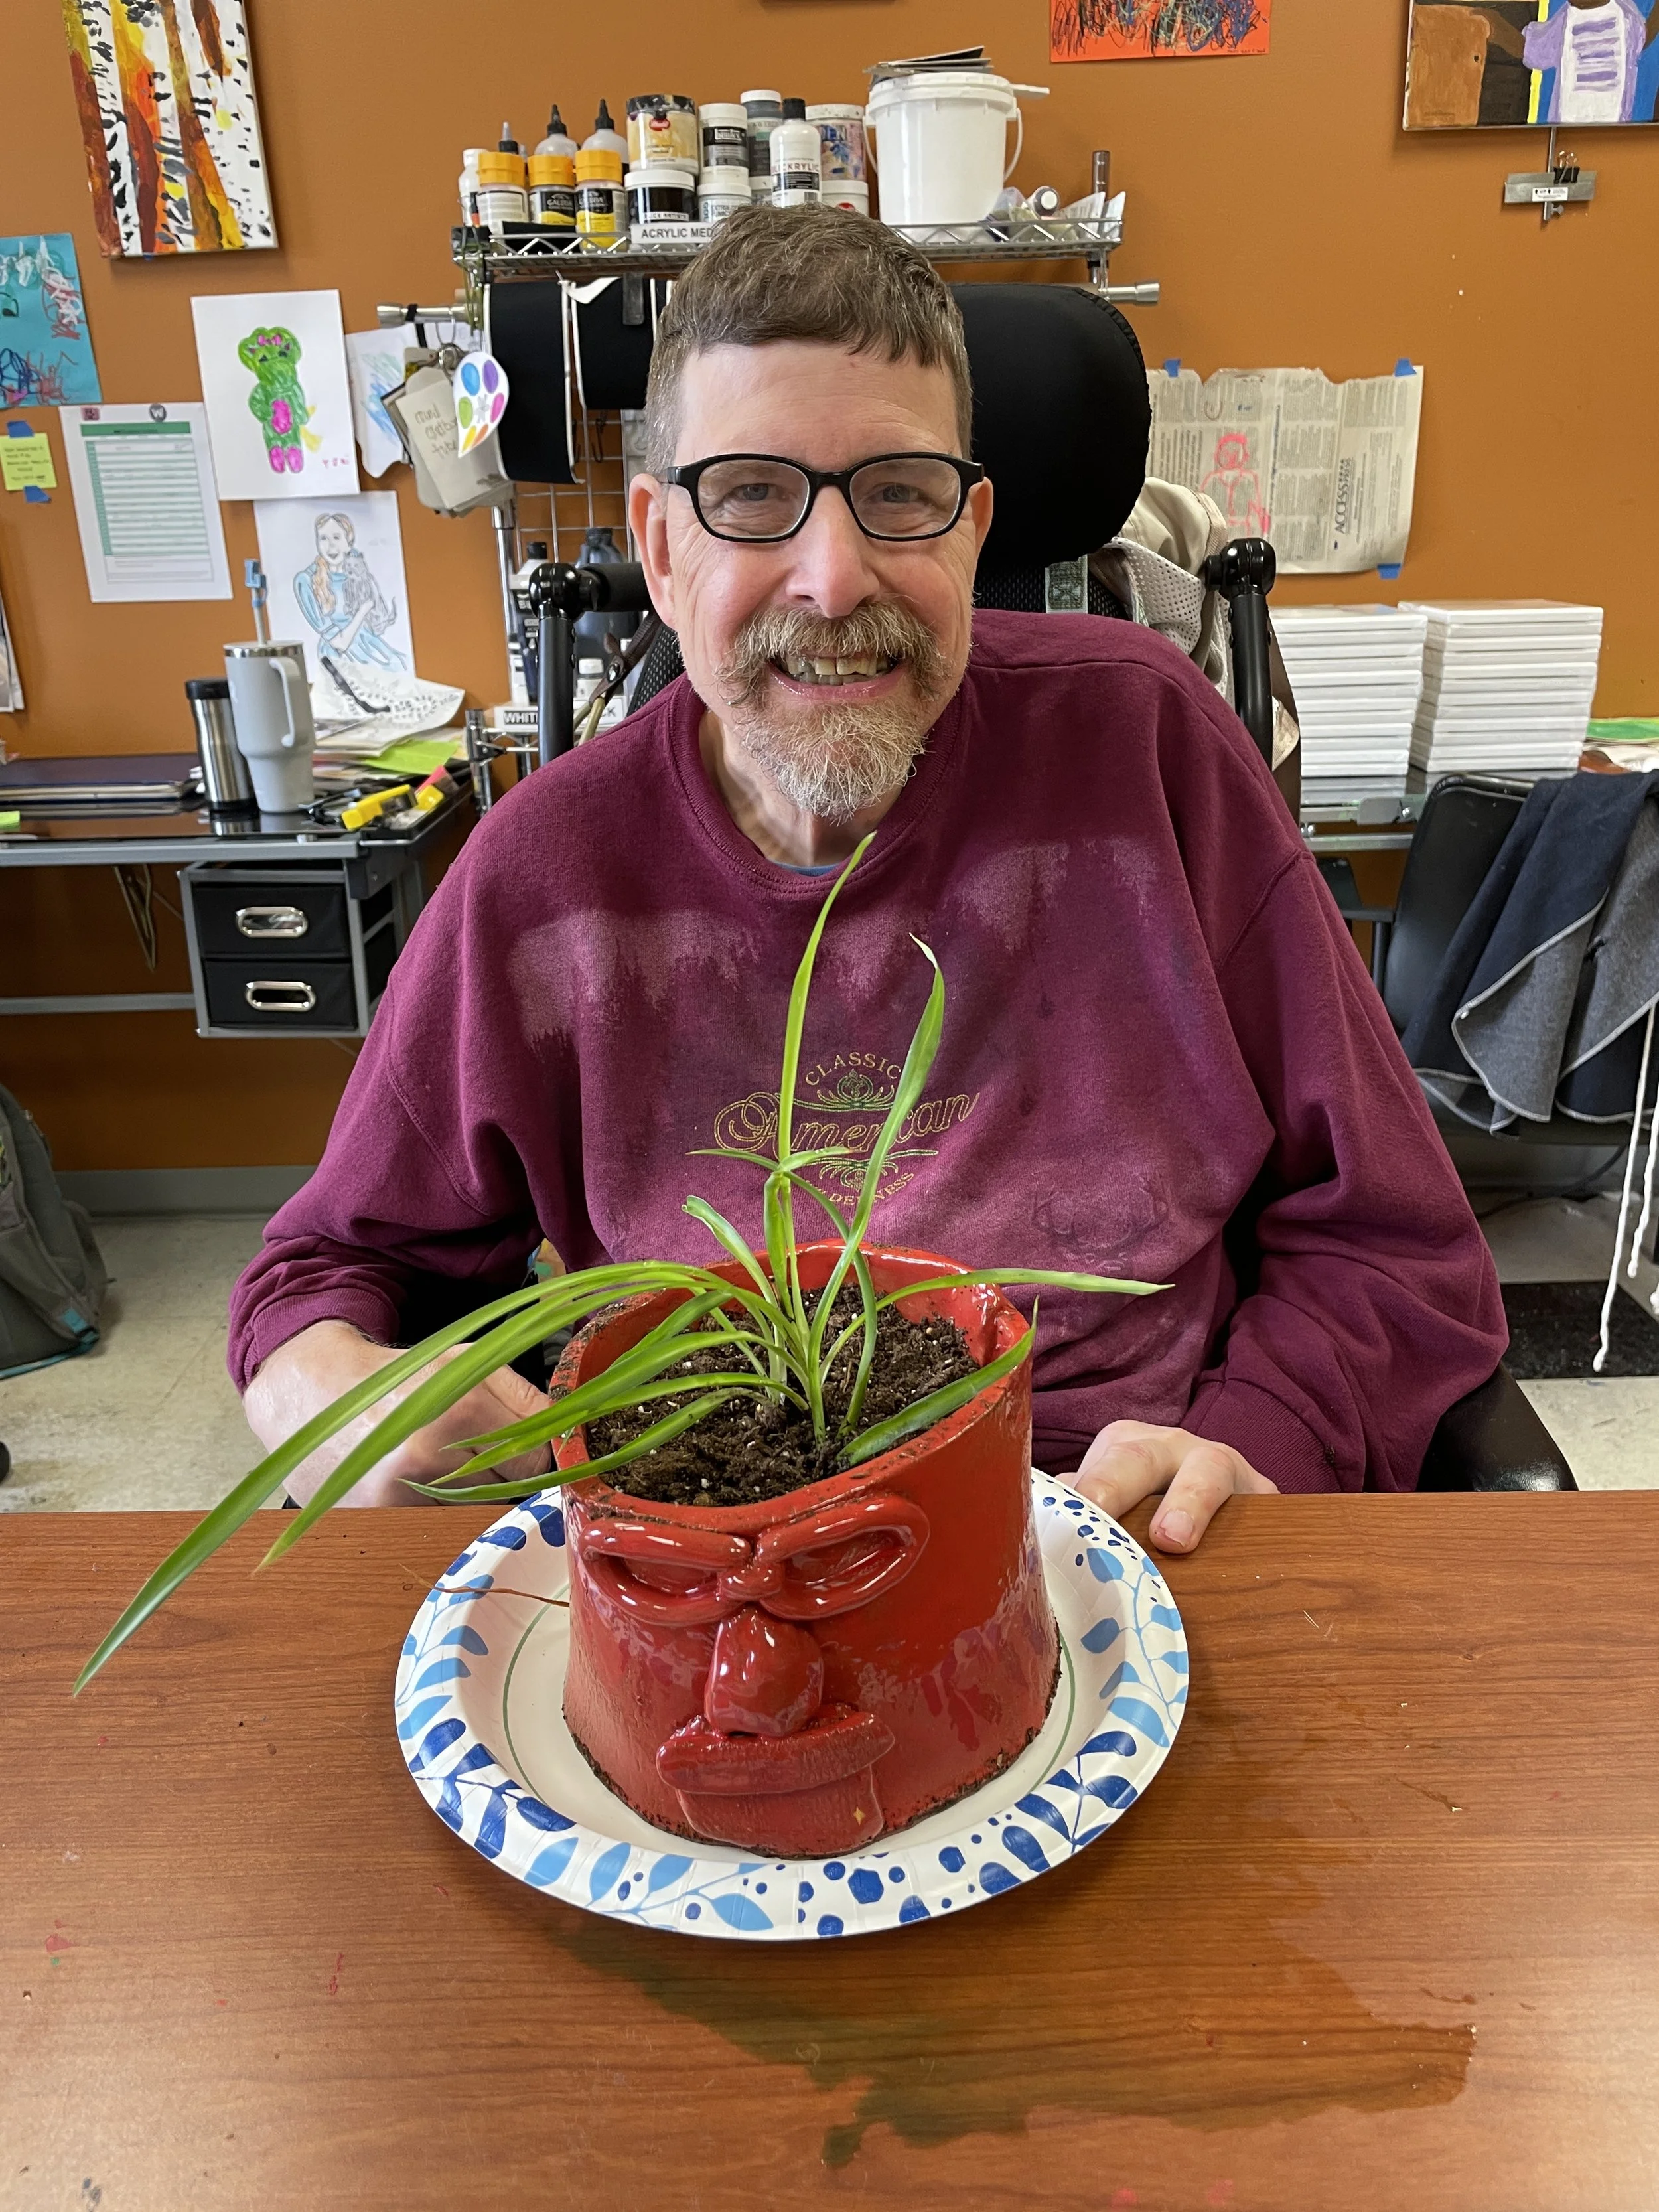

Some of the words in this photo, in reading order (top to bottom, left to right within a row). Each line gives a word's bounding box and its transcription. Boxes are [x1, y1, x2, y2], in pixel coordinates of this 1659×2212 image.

[641, 229, 687, 238] ACRYLIC
[504, 711, 538, 724] WHIT
[805, 1051, 901, 1086] CLASSIC
[714, 1092, 980, 1159] Amercan
[806, 1173, 914, 1206] DENESS
